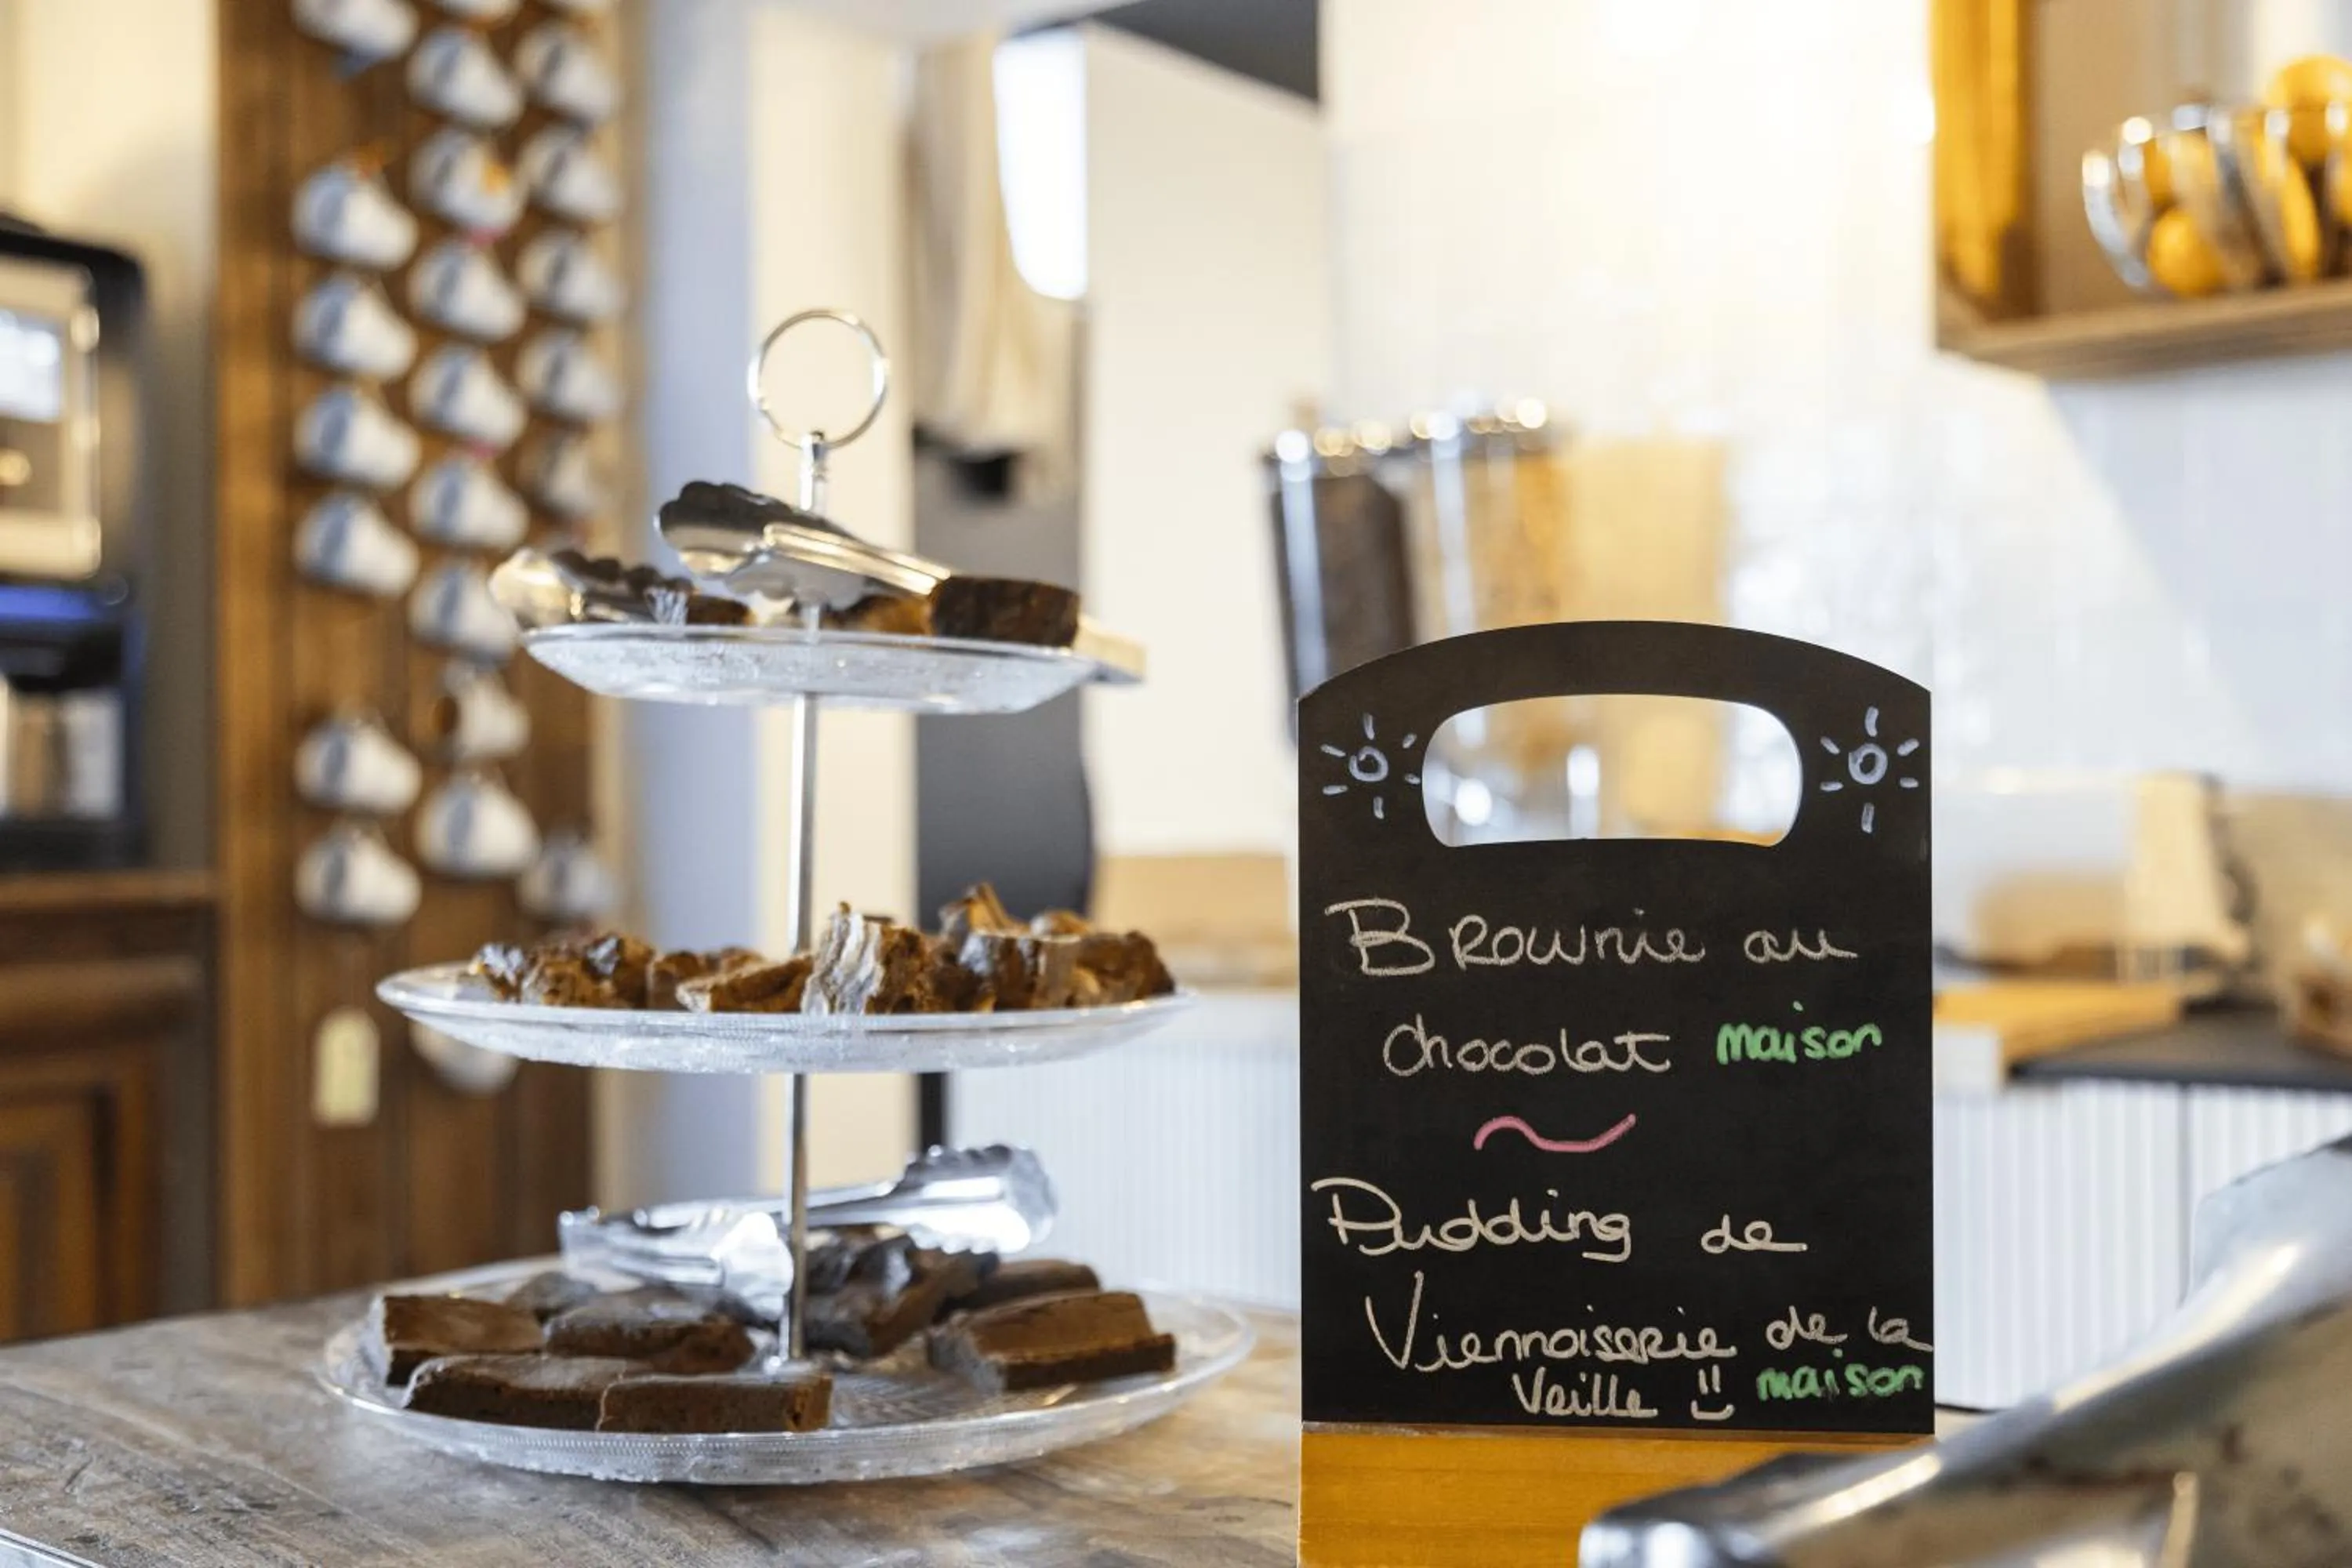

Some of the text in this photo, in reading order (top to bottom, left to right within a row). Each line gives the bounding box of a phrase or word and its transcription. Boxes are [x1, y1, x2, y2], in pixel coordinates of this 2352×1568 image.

[1744, 931, 1858, 963] au
[1717, 1002, 1882, 1064] maison
[1311, 1178, 1807, 1262] Pudding de
[1366, 1271, 1933, 1372] Viennoiserie de la
[1511, 1348, 1925, 1417] Veille maison
